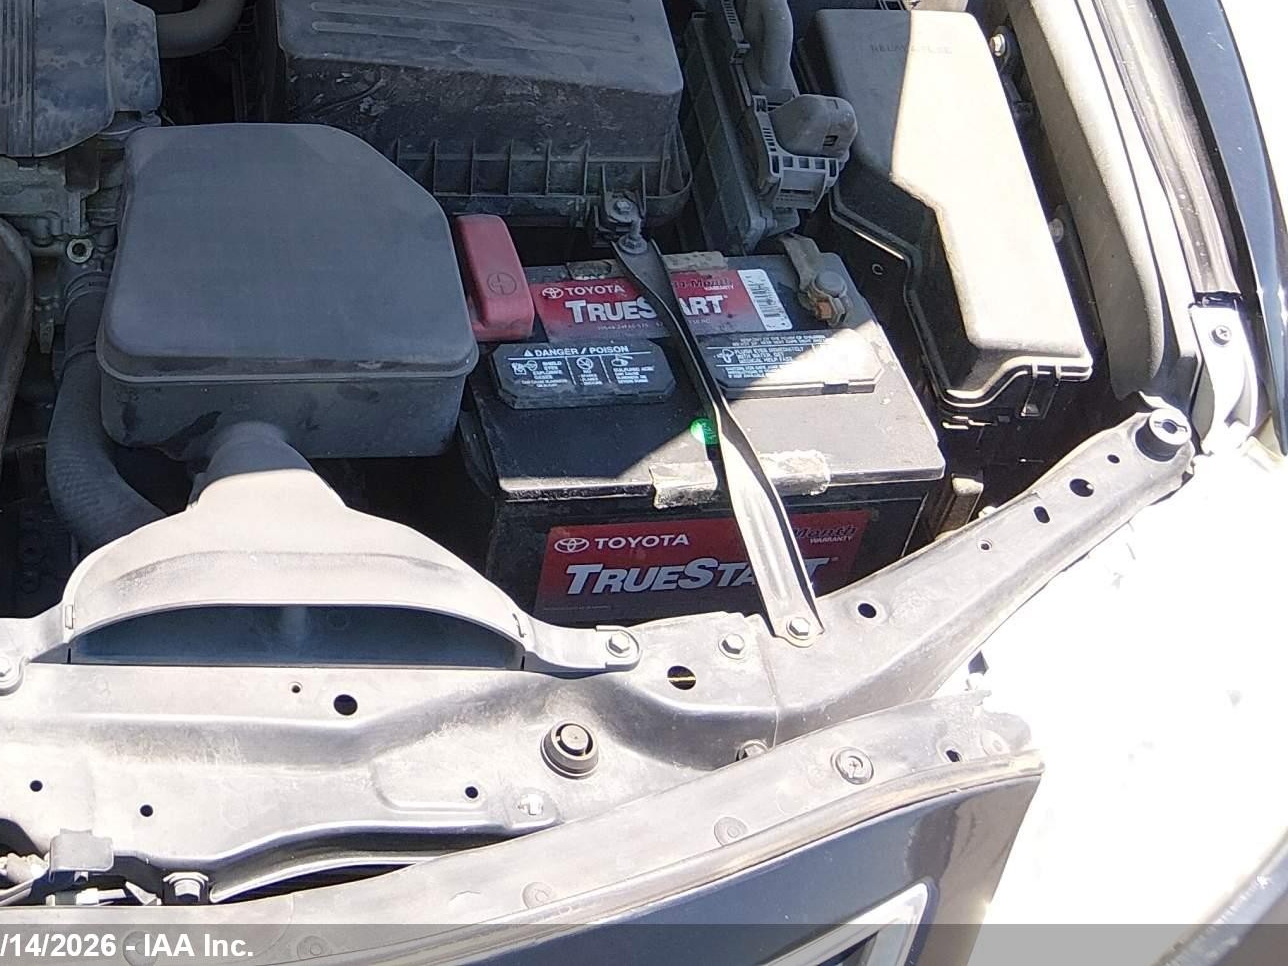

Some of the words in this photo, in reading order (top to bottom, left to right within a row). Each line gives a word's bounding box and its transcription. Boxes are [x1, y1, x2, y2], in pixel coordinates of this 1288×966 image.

[564, 284, 626, 296] TOYOTA
[565, 295, 724, 323] TRUESRT
[534, 347, 580, 357] DANGER
[588, 345, 630, 355] POISON
[594, 533, 689, 551] TOYOTA
[810, 536, 853, 544] WARRANTY
[566, 557, 830, 595] TRUESTAT
